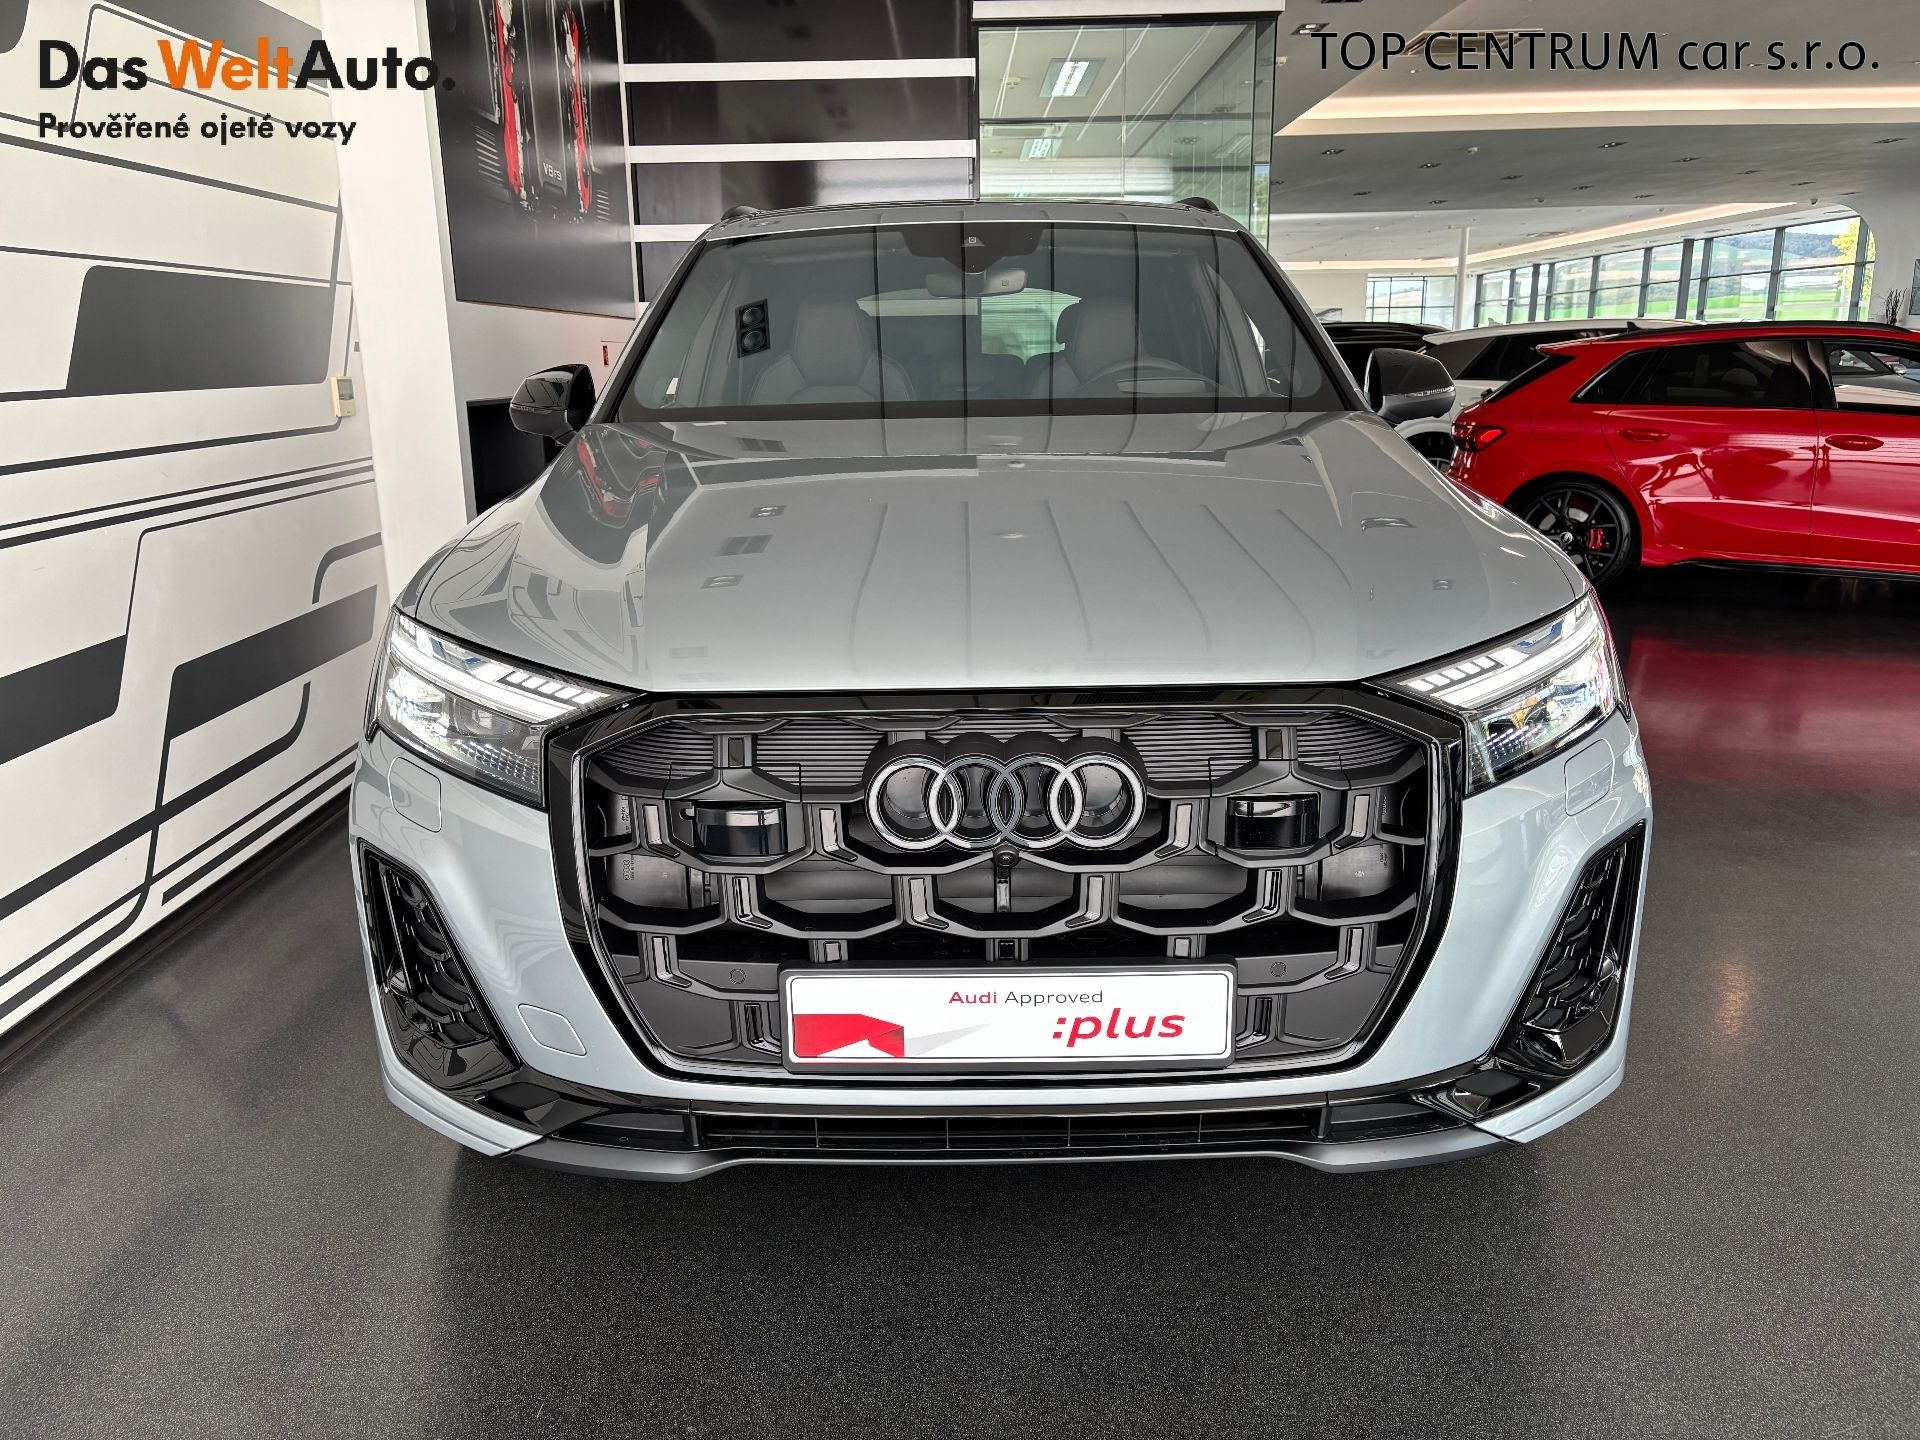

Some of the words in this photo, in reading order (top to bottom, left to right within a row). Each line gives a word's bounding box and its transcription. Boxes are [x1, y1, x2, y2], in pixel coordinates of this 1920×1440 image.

[949, 991, 997, 1004] Audi
[1004, 990, 1104, 1007] Approved
[1052, 1007, 1186, 1048] :plus
